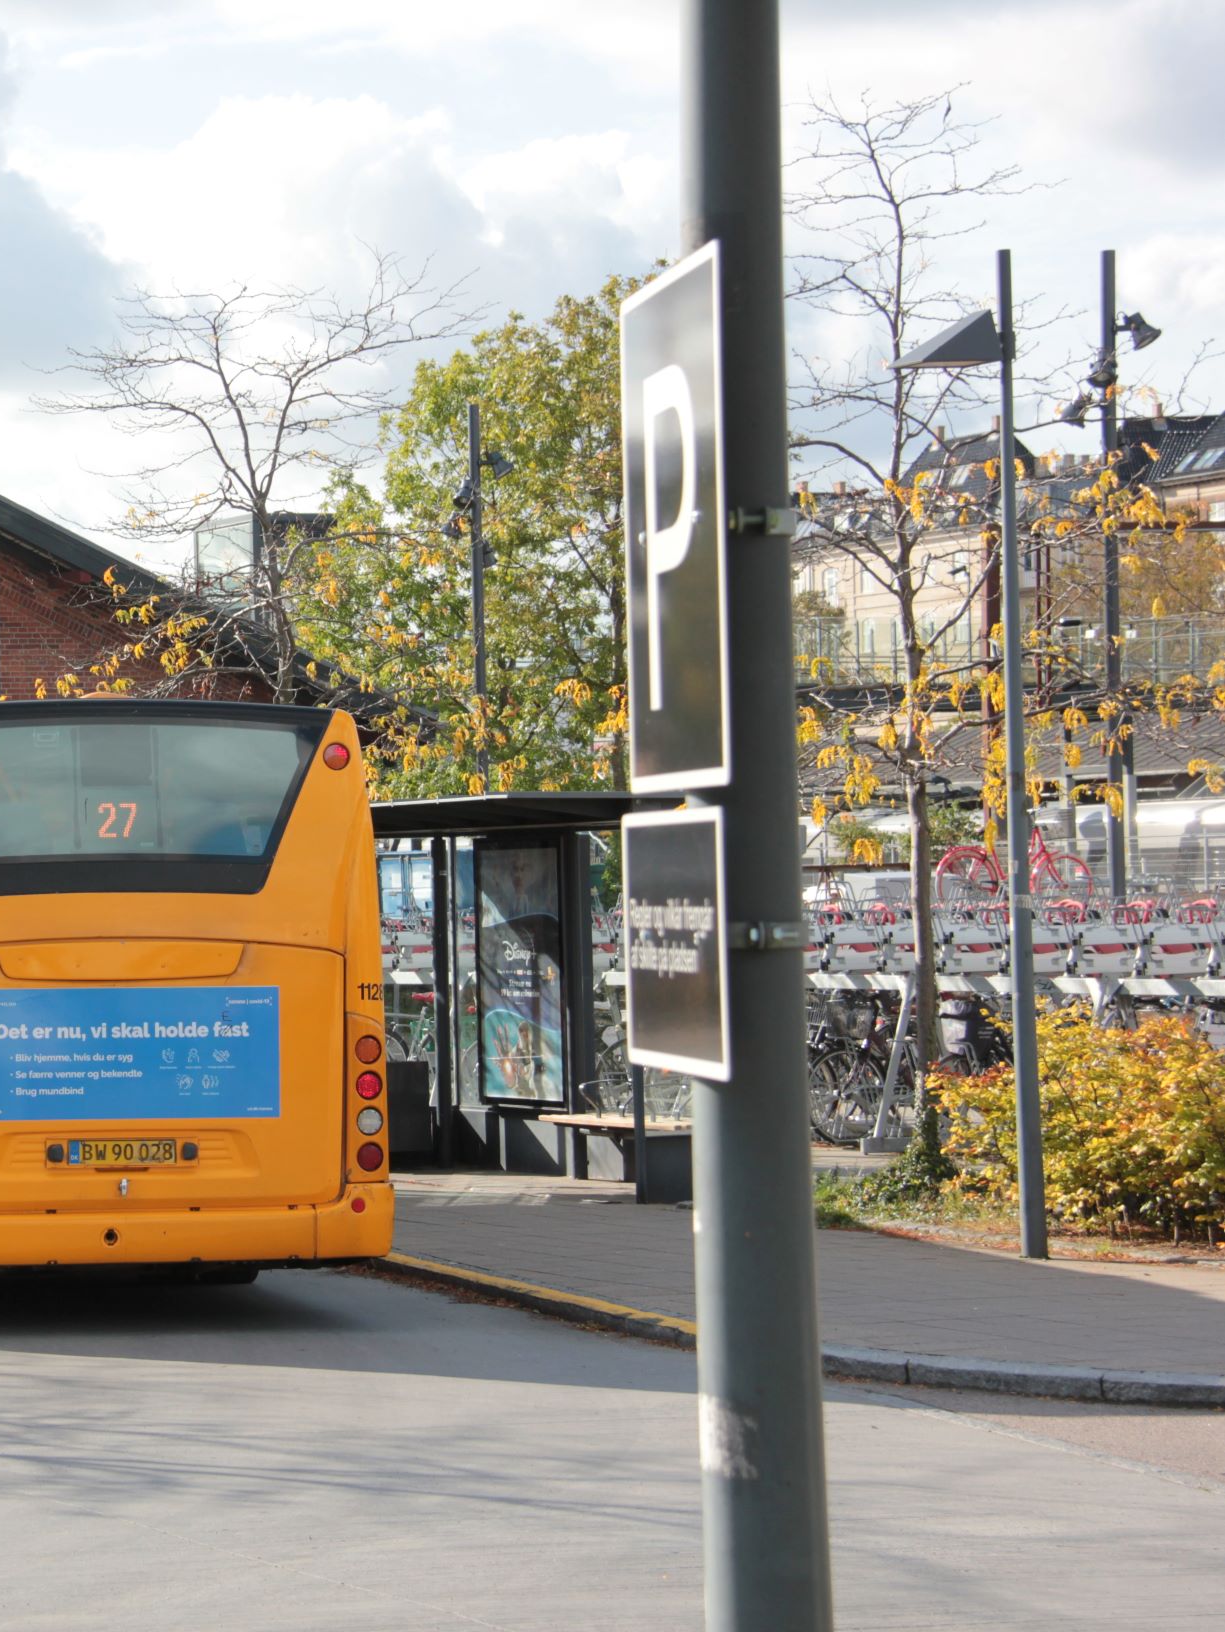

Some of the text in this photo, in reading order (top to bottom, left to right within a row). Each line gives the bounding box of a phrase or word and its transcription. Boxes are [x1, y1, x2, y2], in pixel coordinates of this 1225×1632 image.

[643, 364, 695, 711] P
[96, 802, 137, 838] 27
[32, 1026, 53, 1039] er
[57, 1026, 86, 1041] nu,
[91, 1022, 107, 1038] vi
[111, 1022, 150, 1038] skal
[154, 1021, 209, 1038] holde
[15, 1053, 32, 1062] Bliv
[33, 1053, 72, 1063] hjemme,
[73, 1053, 91, 1062] hvis
[92, 1053, 104, 1061] du
[117, 1054, 133, 1063] syg
[15, 1070, 27, 1079] Se
[28, 1070, 53, 1078] færre
[87, 1071, 99, 1080] og
[100, 1069, 143, 1078] bekendte
[15, 1086, 84, 1097] Brug mundbind
[81, 1143, 108, 1161] BW
[112, 1143, 134, 1161] 90
[138, 1143, 173, 1161] 028
